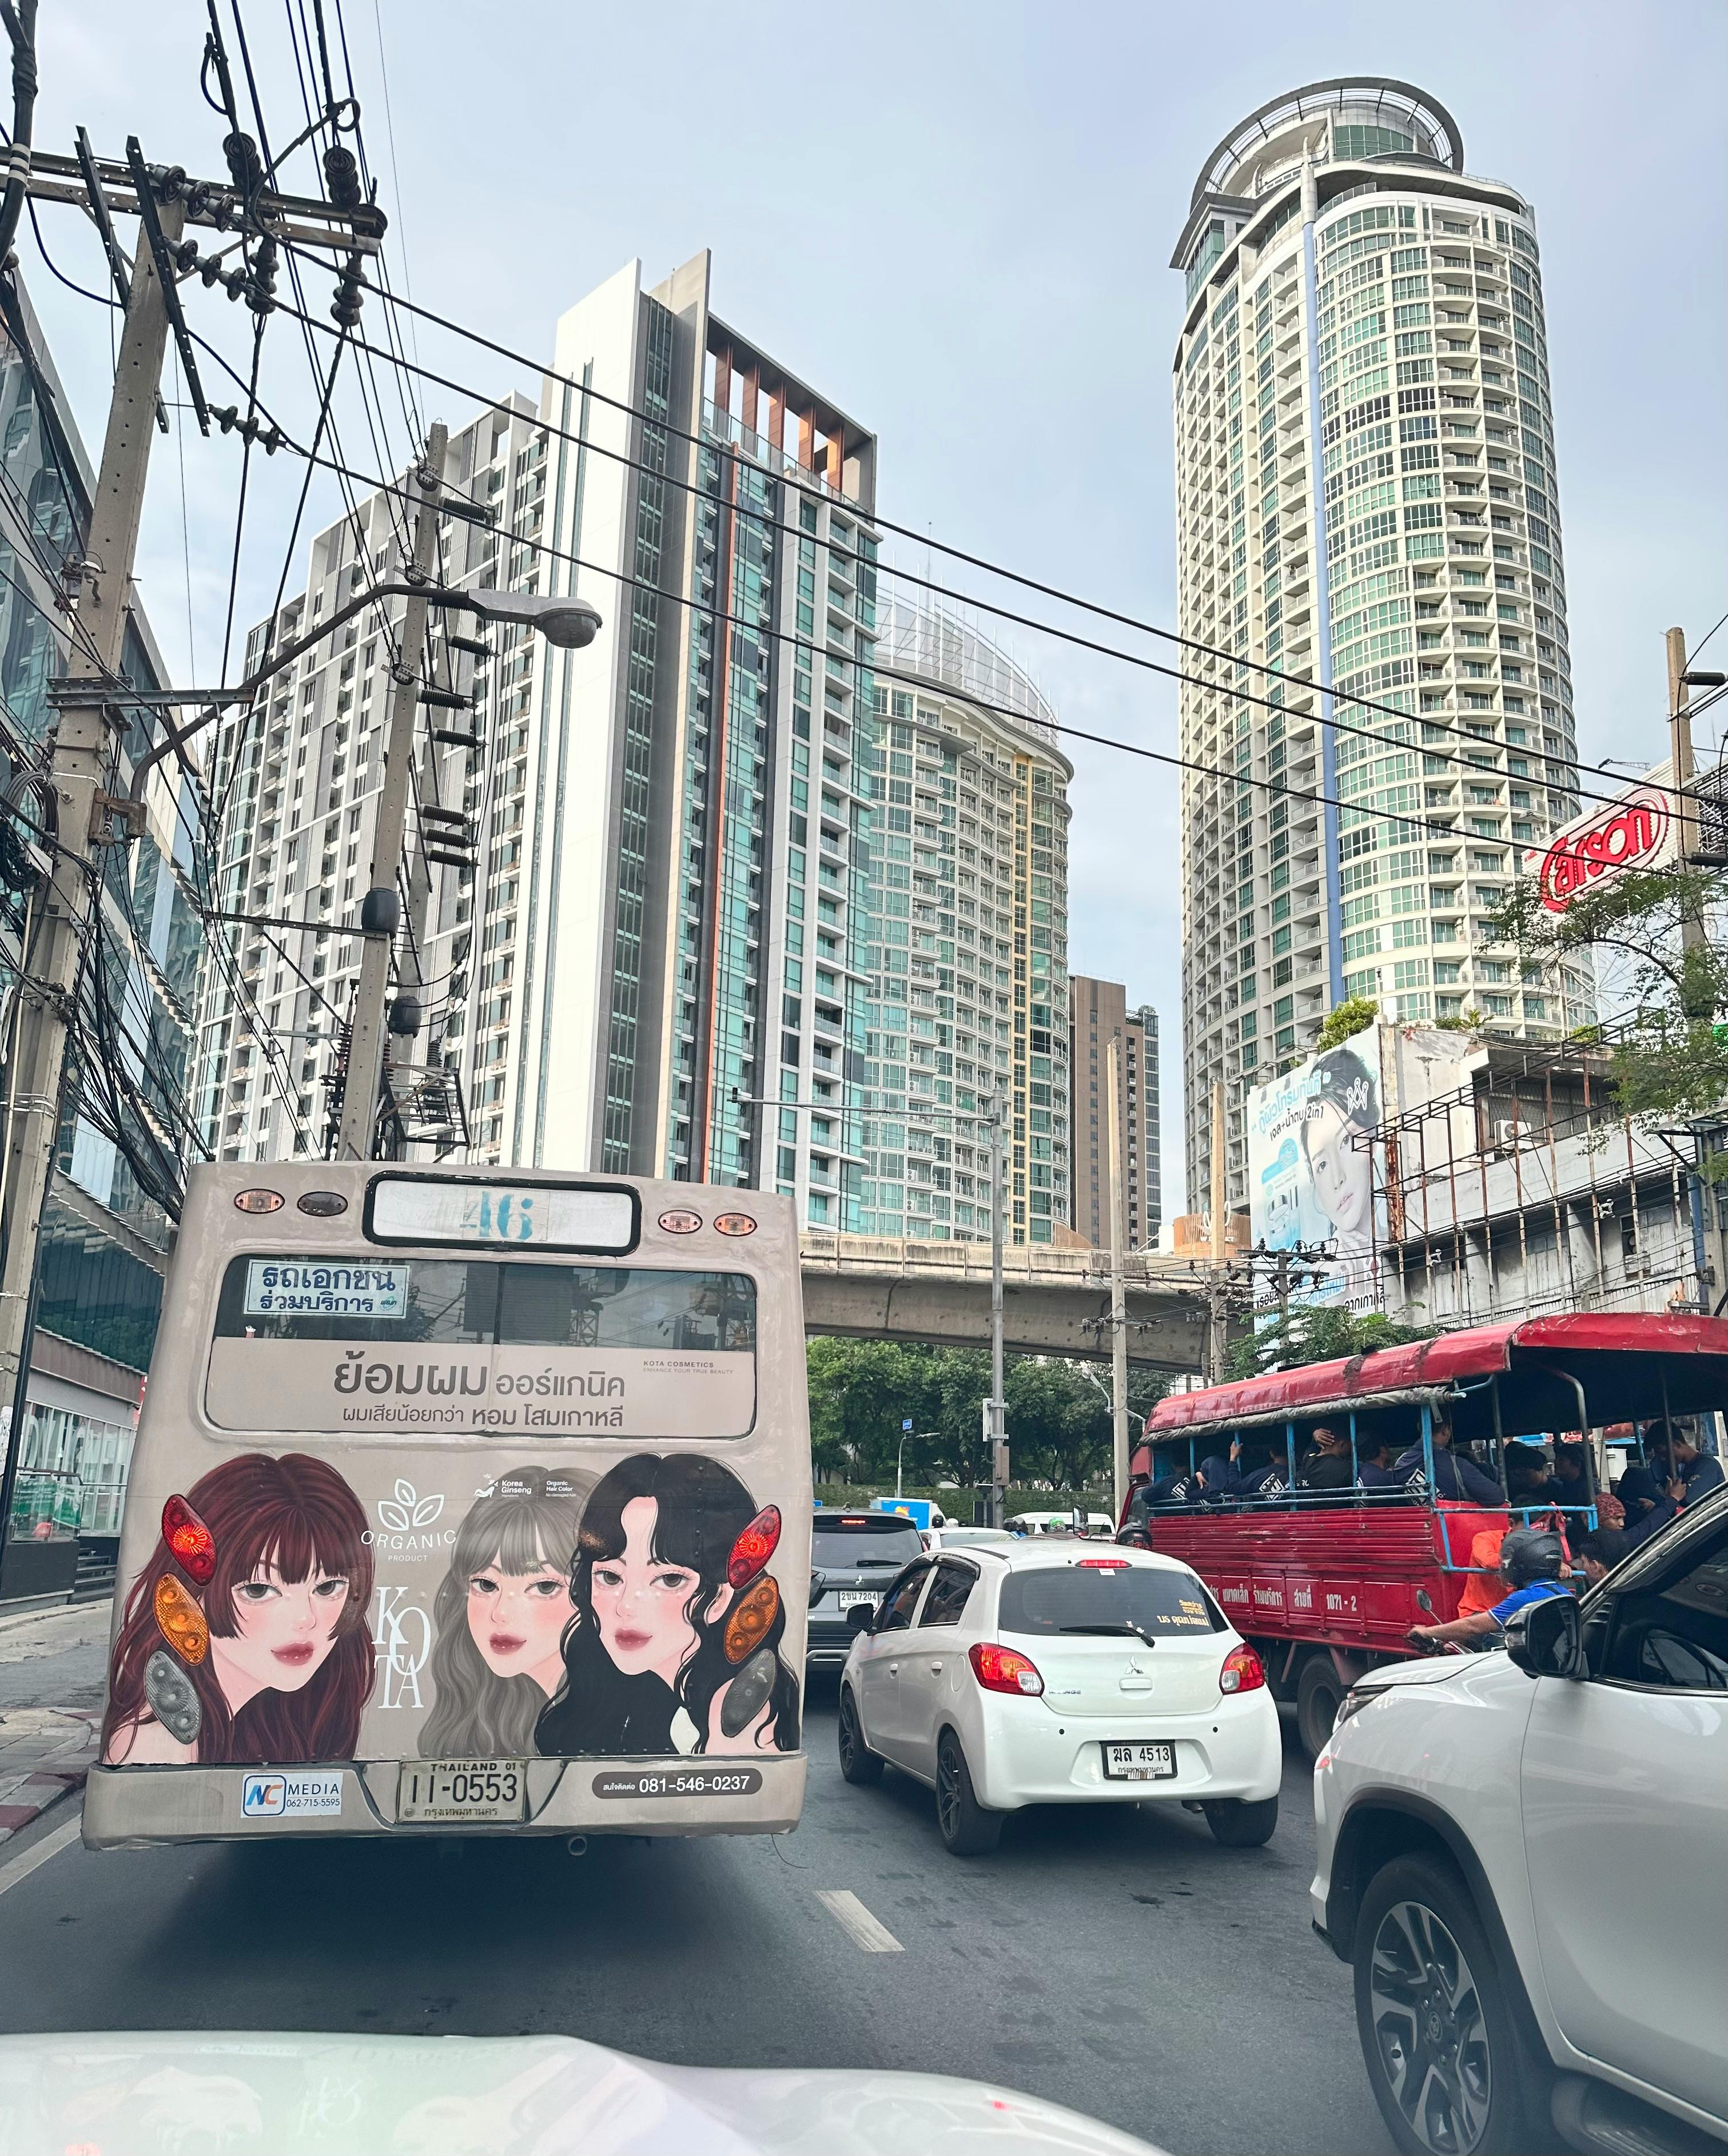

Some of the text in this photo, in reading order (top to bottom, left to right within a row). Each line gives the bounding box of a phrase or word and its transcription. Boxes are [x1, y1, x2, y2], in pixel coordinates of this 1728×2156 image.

[1307, 1104, 1324, 1119] 2in1
[460, 1191, 533, 1240] 46
[262, 1266, 396, 1291] รถเอกชน
[260, 1290, 373, 1312] ร่วมบริการ
[334, 1350, 625, 1397] ย้อมผม ออร์แกนิค
[343, 1403, 624, 1426] ผมเสียน้อยกว่า หอม โสมเกาหลี
[501, 1487, 532, 1495] Ginseng
[361, 1529, 456, 1549] ORGANIC
[841, 1592, 877, 1600] 2ขน 7204
[1253, 1584, 1283, 1606] ร่วมบริการ
[1294, 1585, 1312, 1608] สายที่
[1326, 1593, 1343, 1610] 1071
[1351, 1595, 1357, 1611] 2
[1140, 1747, 1169, 1762] 4513
[431, 1763, 497, 1772] THAILAND
[412, 1774, 517, 1803] 11-0553
[603, 1775, 750, 1793] สนใจติดต่อ 081-546-0237
[246, 1784, 339, 1806] NC MEDIA
[286, 1798, 340, 1807] 062-715-5595
[424, 1807, 498, 1819] กรุงเทพมหานคร
